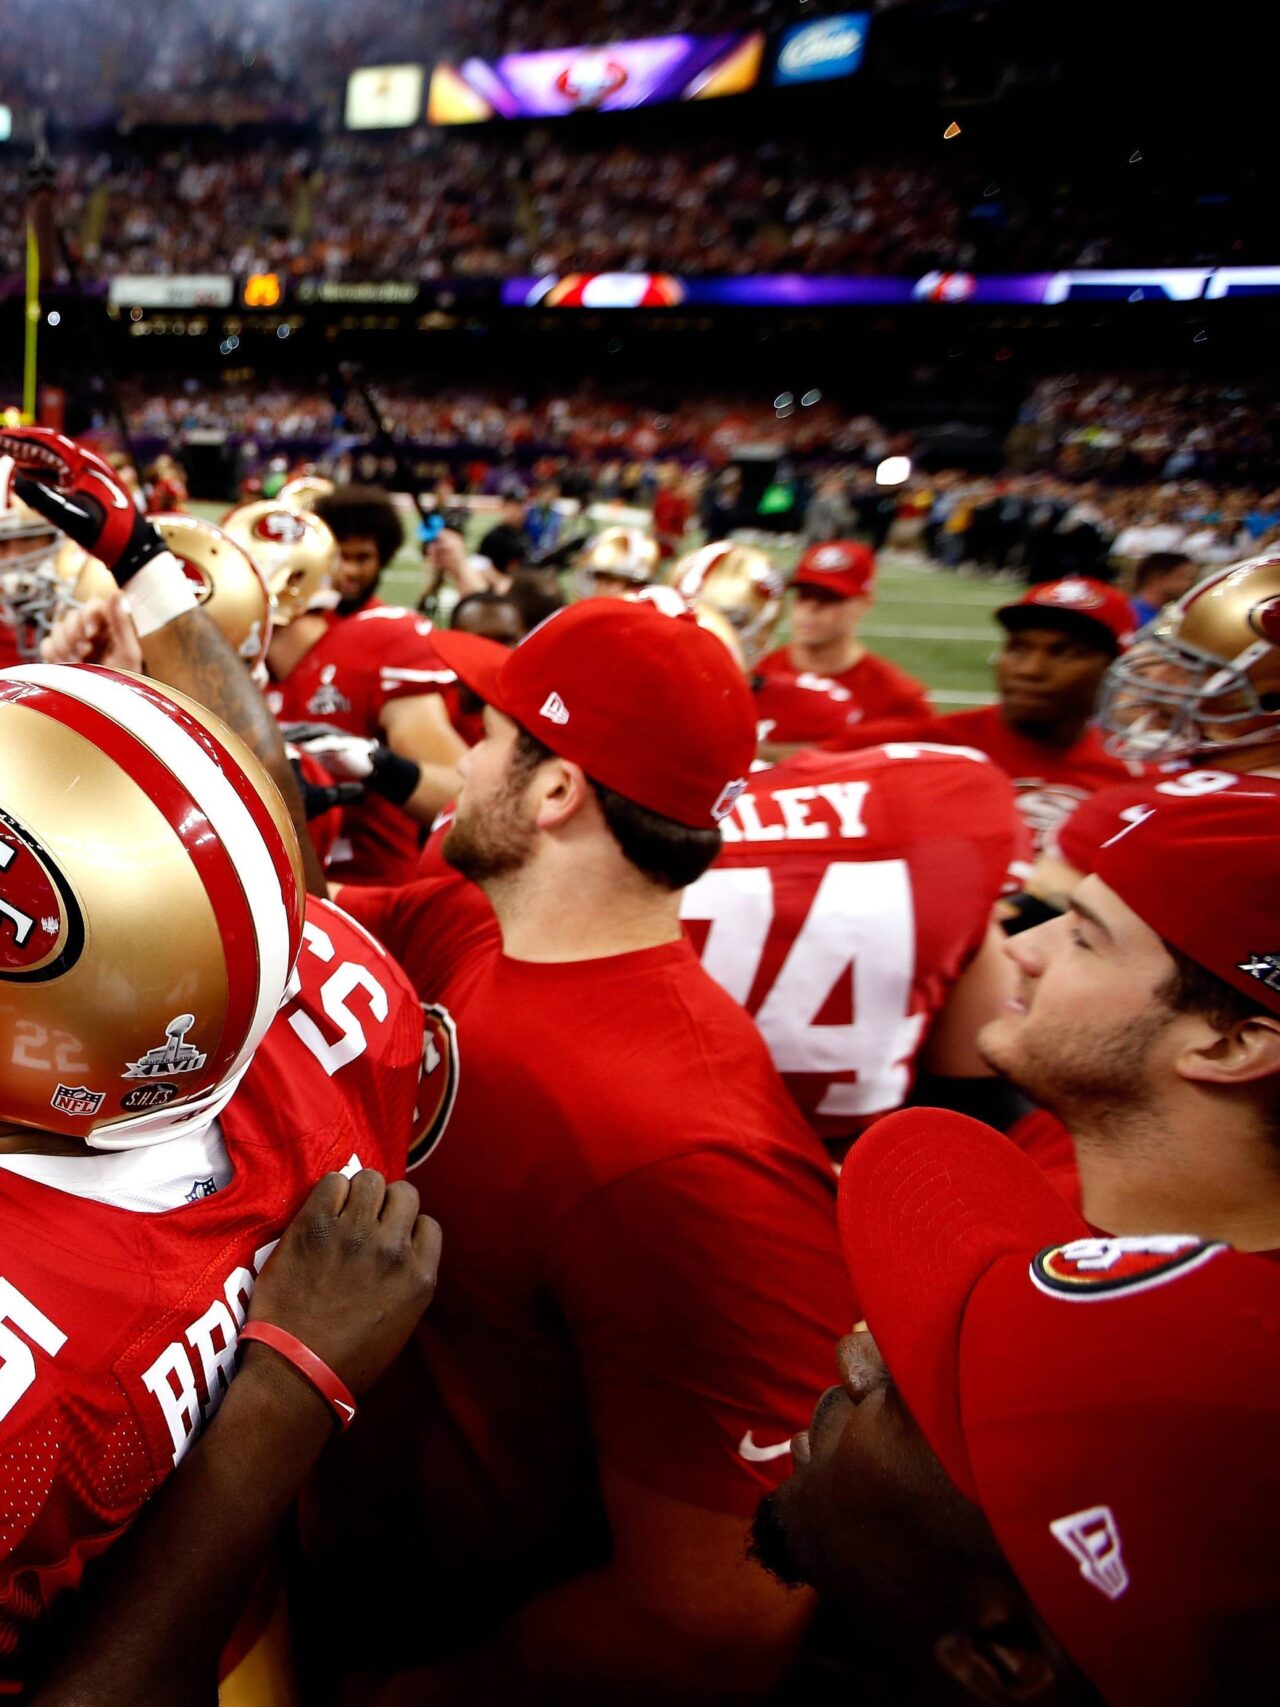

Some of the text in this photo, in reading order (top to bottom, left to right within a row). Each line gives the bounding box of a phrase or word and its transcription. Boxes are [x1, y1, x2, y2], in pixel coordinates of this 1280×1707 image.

[678, 859, 927, 1116] 74
[11, 1020, 90, 1073] 22
[121, 1053, 207, 1077] XLVII
[57, 1096, 93, 1113] NFL
